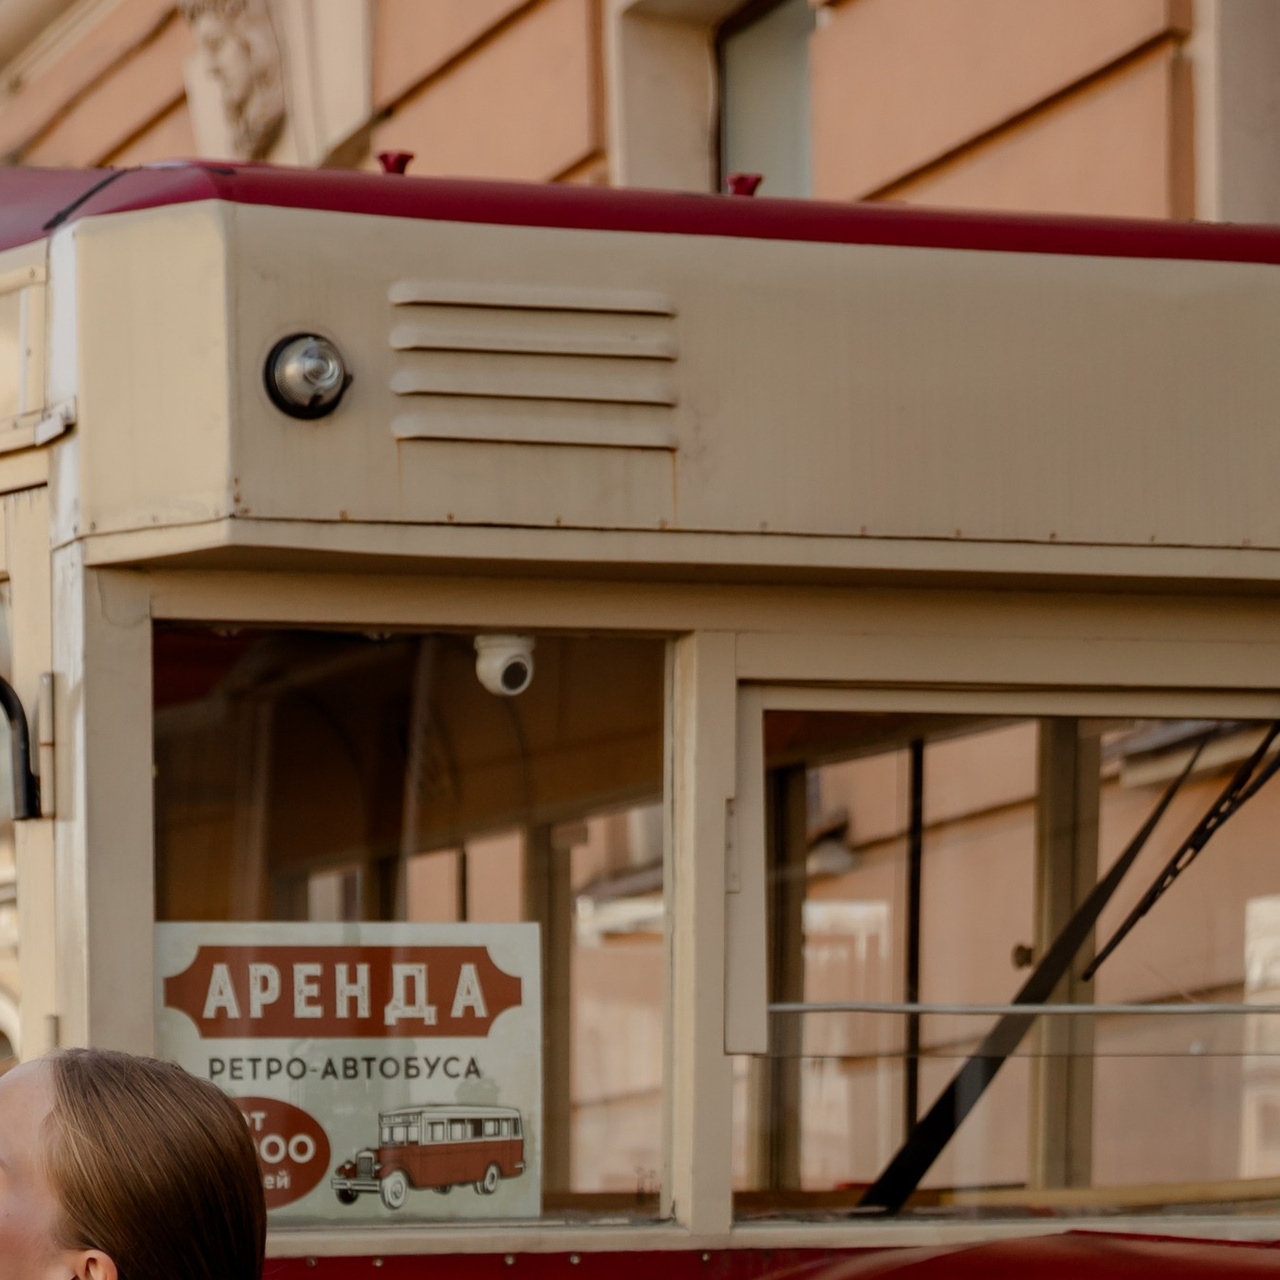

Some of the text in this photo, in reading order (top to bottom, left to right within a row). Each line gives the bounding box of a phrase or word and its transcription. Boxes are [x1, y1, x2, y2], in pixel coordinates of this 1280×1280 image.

[202, 963, 488, 1025] АРЕНДА
[208, 1056, 482, 1080] РЕТРО-АВТОБУСА
[254, 1134, 315, 1164] 00
